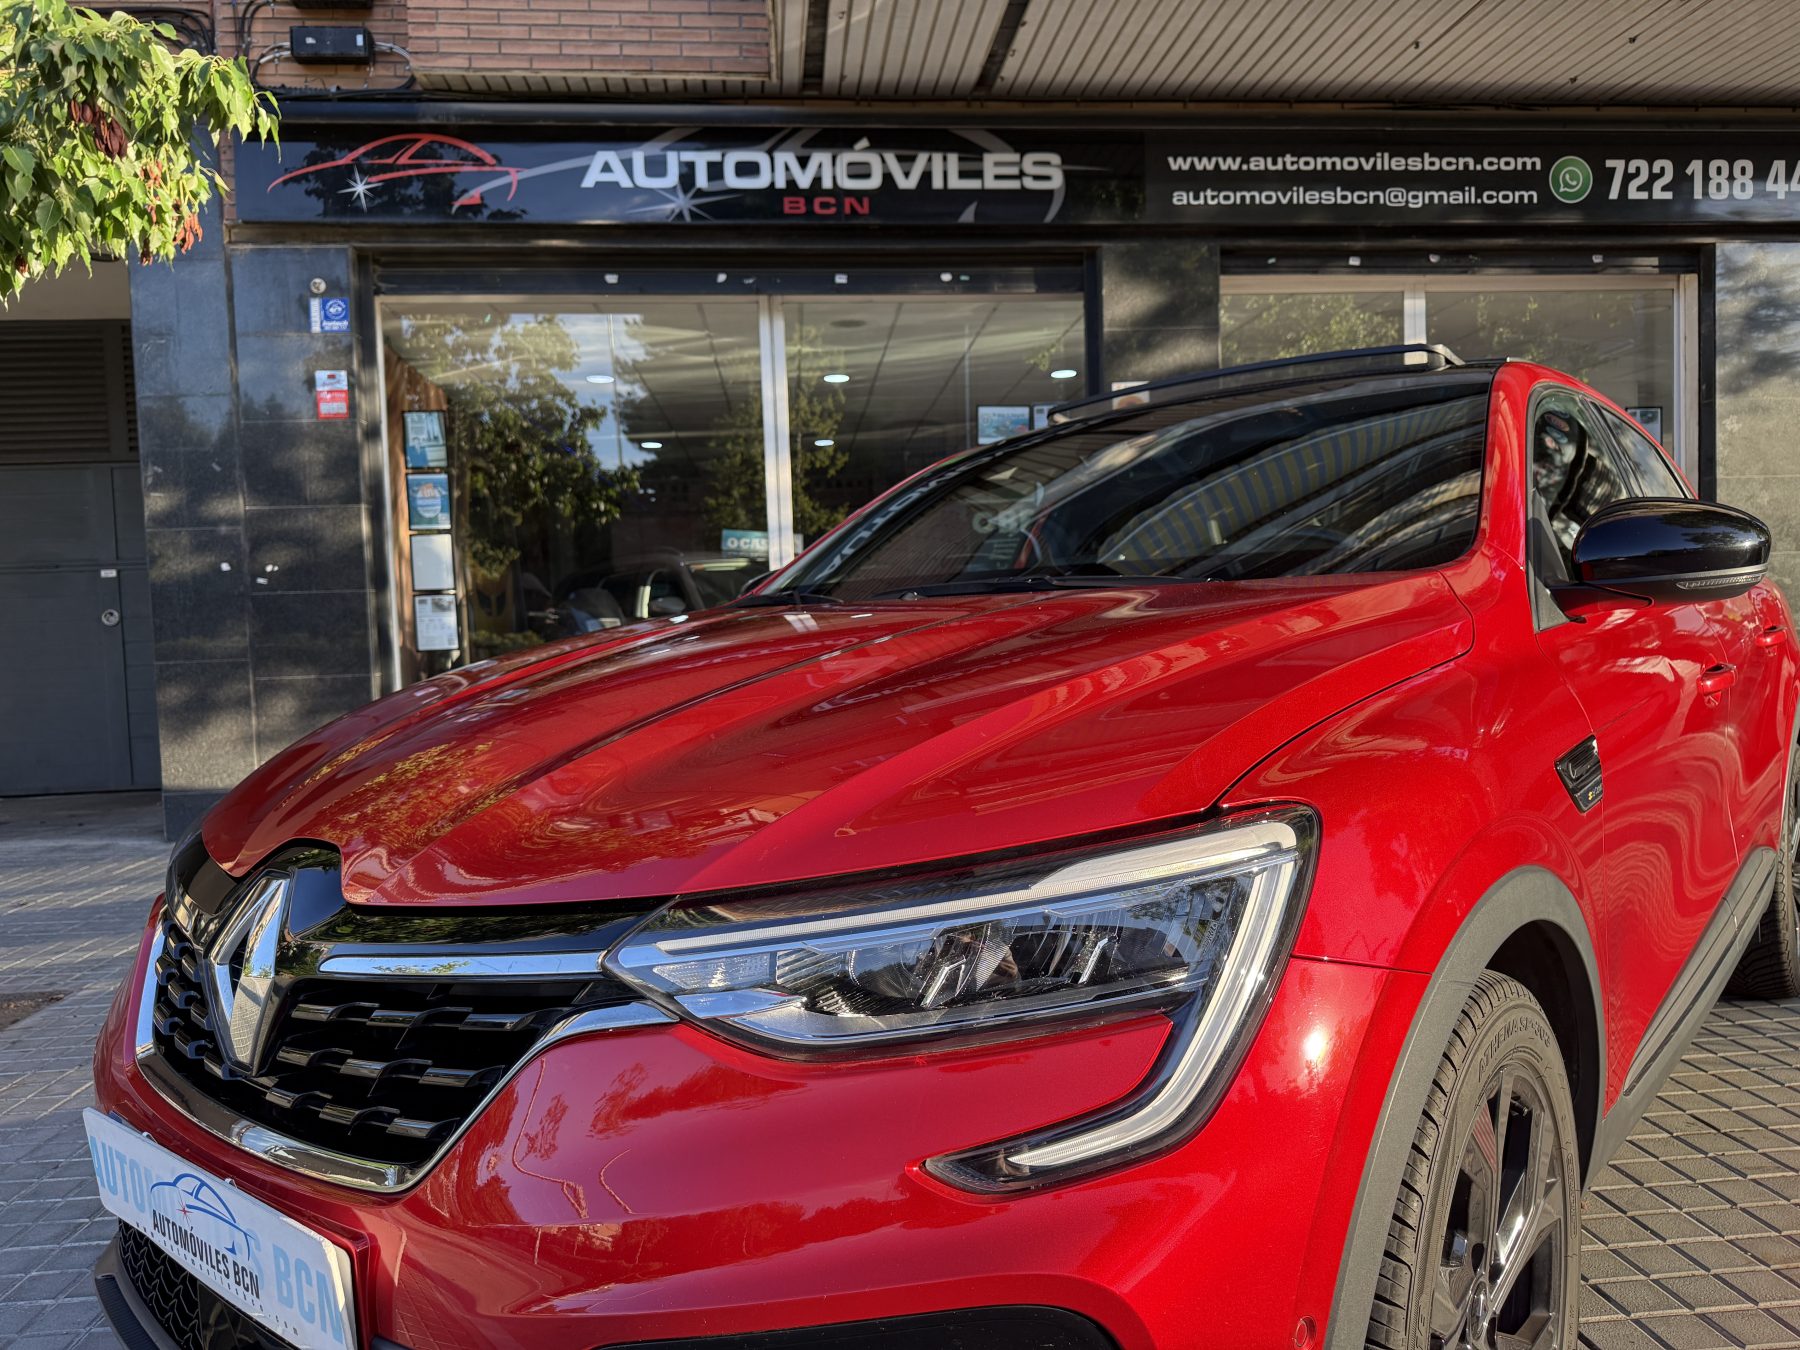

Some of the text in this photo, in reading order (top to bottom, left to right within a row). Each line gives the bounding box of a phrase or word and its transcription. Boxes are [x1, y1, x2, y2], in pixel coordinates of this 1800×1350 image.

[580, 136, 1064, 190] AUTOMÓVILES
[1167, 152, 1542, 171] www.automovilesbcn.com
[1605, 158, 1674, 200] 722
[1685, 158, 1754, 200] 188
[783, 196, 870, 215] BCN
[1172, 186, 1538, 208] automovilesbcn@gmail.com
[153, 1208, 260, 1300] AUTOMÓVILES BCN
[272, 1243, 344, 1345] BCN
